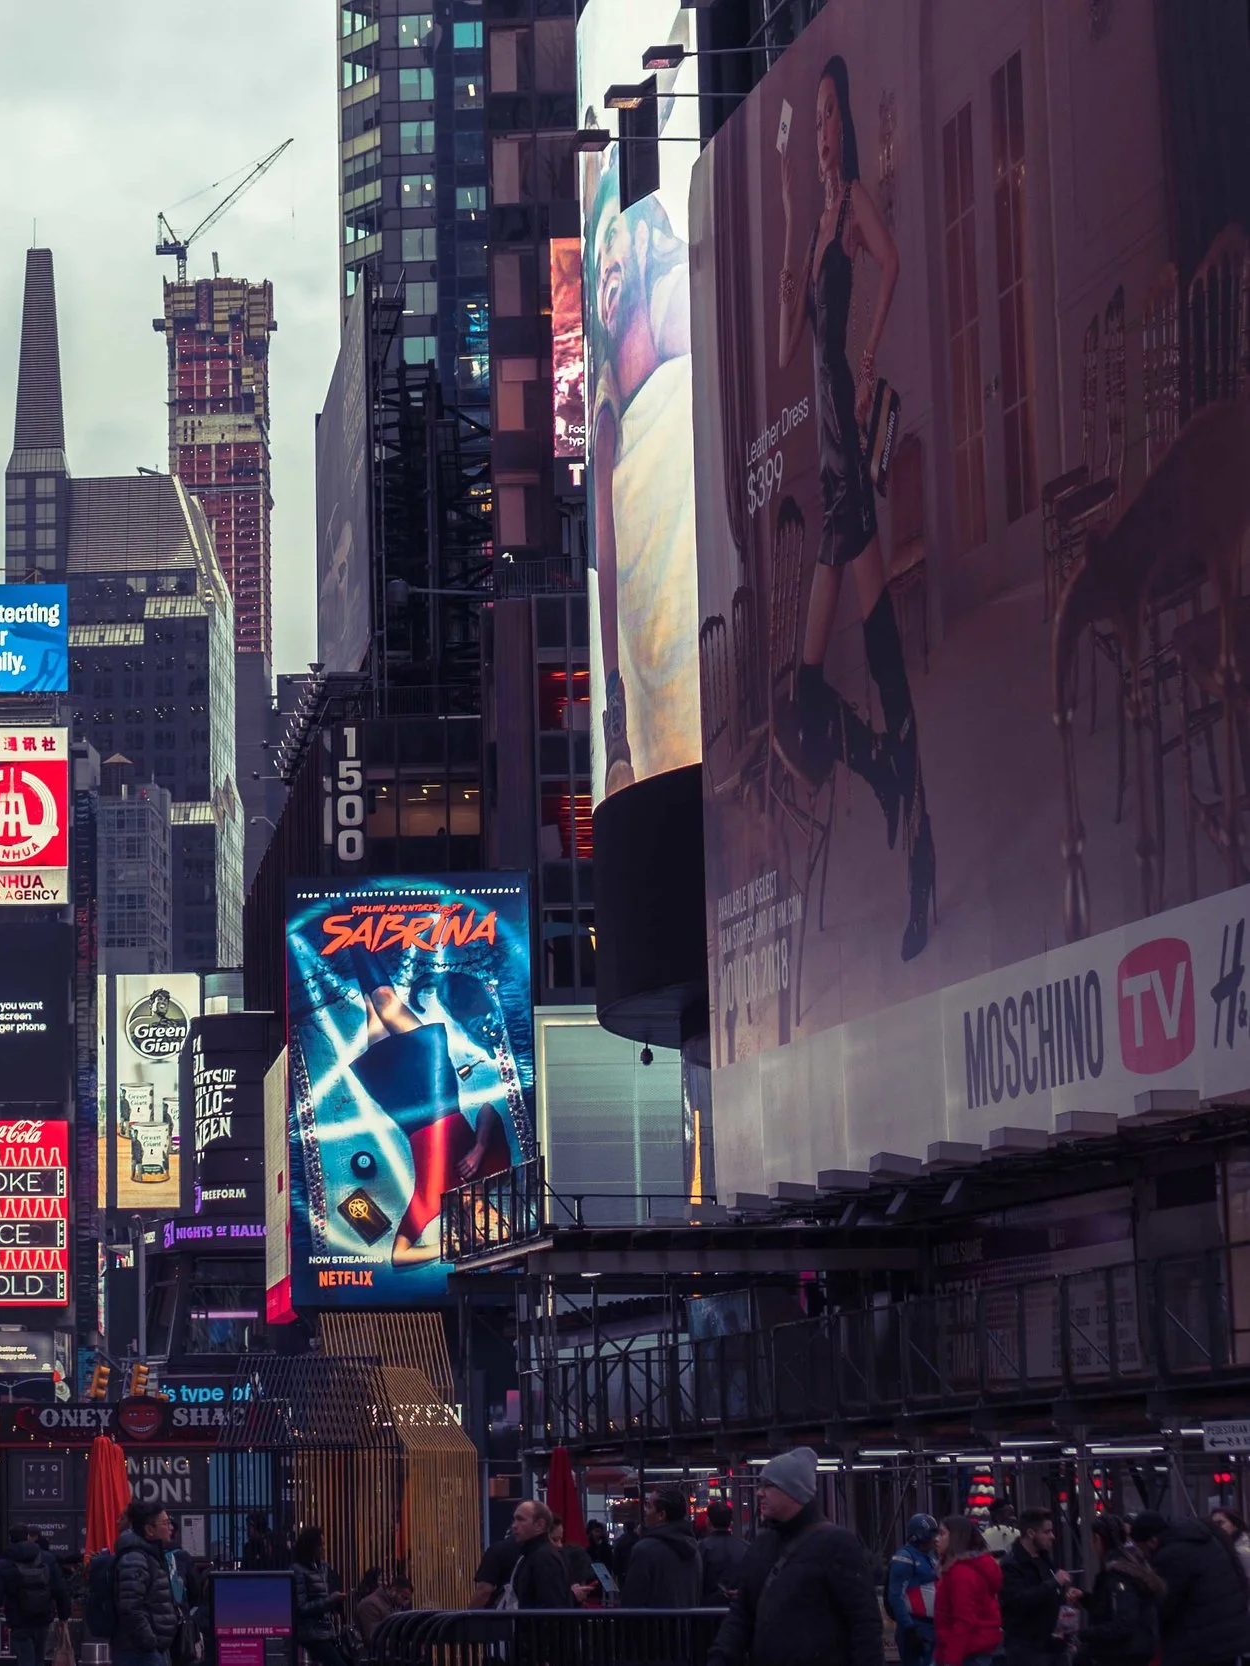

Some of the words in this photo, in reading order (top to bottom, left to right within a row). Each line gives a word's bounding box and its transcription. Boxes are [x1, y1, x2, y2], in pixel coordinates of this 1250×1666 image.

[746, 420, 781, 467] Leather
[782, 396, 809, 436] Dress
[881, 410, 896, 472] MOSCHINO
[747, 450, 783, 519] $399
[337, 727, 365, 861] 1500
[5, 889, 59, 900] AGENCY
[718, 886, 747, 920] AVAILABLE
[748, 882, 755, 909] IN
[755, 870, 777, 905] SELECT
[388, 903, 440, 913] ADVENTURES
[732, 916, 754, 949] STORES
[755, 910, 768, 940] AND
[769, 906, 776, 933] AT
[777, 892, 803, 929] HM.COM
[320, 908, 496, 956] SABRINA
[0, 1002, 17, 1012] you
[18, 1001, 43, 1010] want
[964, 969, 1104, 1110] MOSCHINO
[1122, 961, 1187, 1049] TV
[1210, 917, 1250, 1050] H&
[0, 1013, 32, 1021] screen
[16, 1022, 47, 1033] phone
[134, 1023, 186, 1039] Green
[202, 1188, 246, 1200] FREEFORM
[164, 1220, 175, 1249] 31
[176, 1225, 213, 1239] NIGHTS
[216, 1225, 227, 1236] OF
[309, 1256, 331, 1264] NOW
[332, 1256, 383, 1264] STREAMING
[318, 1270, 374, 1288] NETFLIX
[179, 1384, 225, 1404] type
